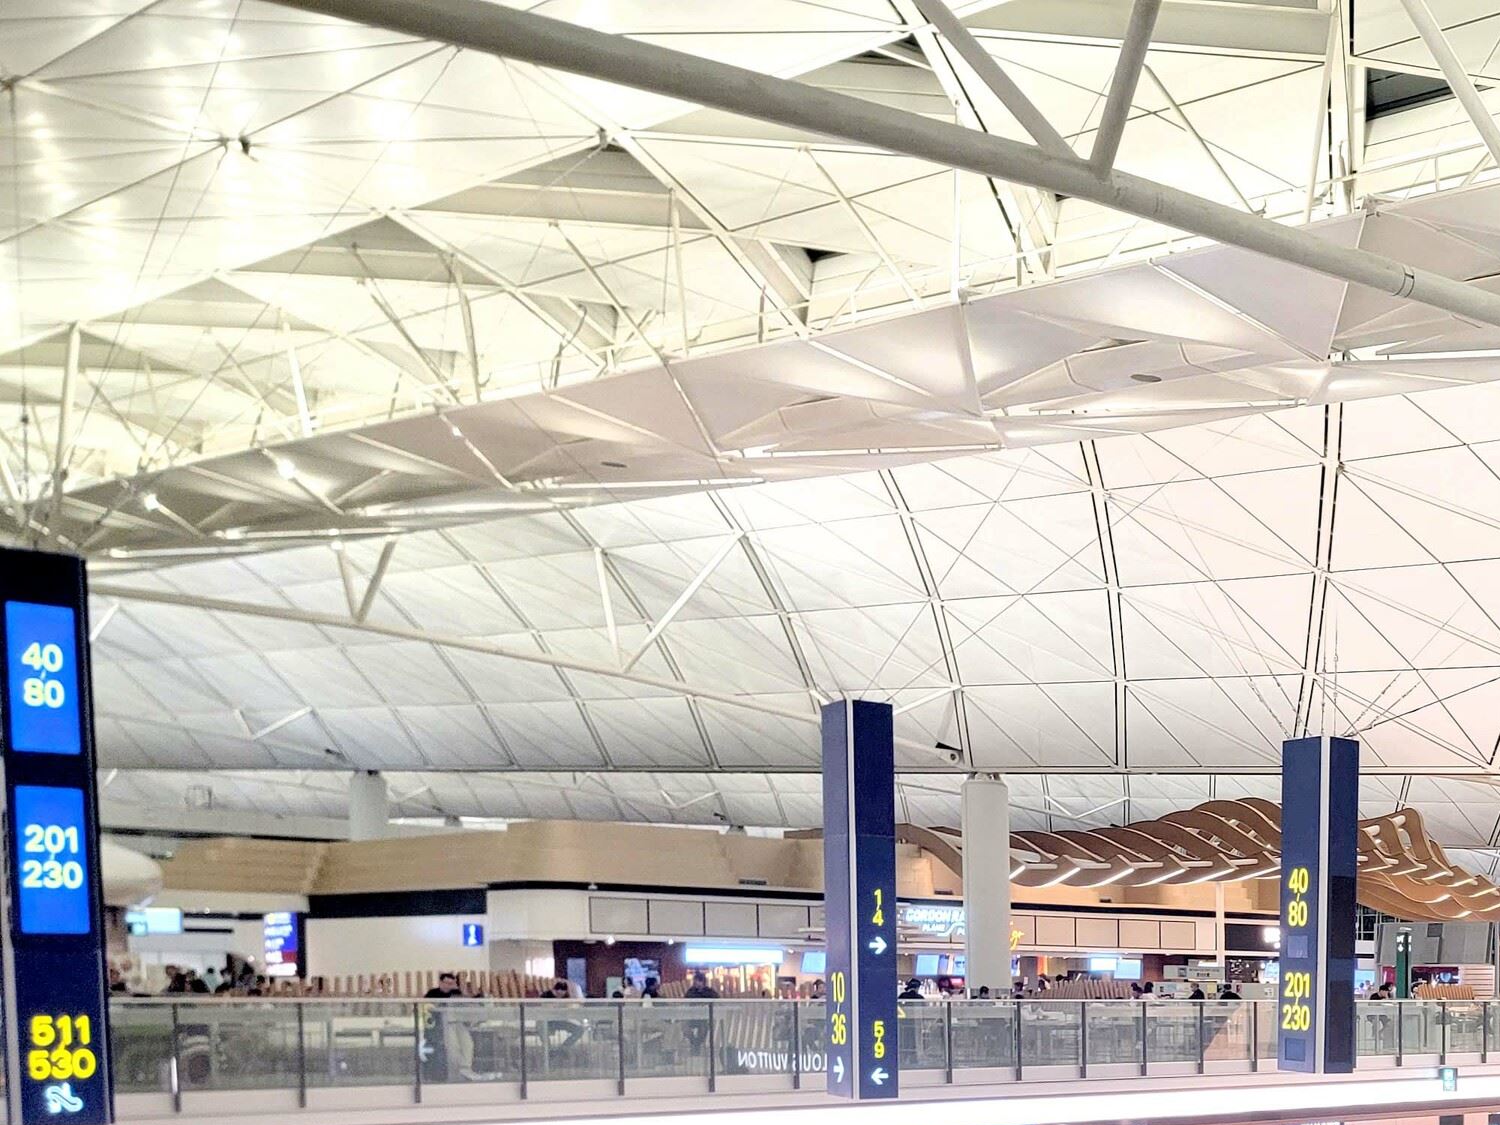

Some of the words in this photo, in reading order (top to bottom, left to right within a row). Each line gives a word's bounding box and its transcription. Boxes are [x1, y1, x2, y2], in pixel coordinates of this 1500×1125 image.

[21, 642, 64, 673] 40
[23, 678, 66, 708] 80
[24, 824, 79, 854] 201
[23, 860, 83, 890] 230
[1288, 868, 1309, 894] 40
[873, 888, 883, 906] 1
[872, 908, 884, 926] 4
[1288, 902, 1308, 927] 80
[831, 972, 845, 1003] 10
[1284, 972, 1311, 998] 201
[30, 1014, 92, 1047] 511
[831, 1013, 847, 1046] 36
[873, 1020, 885, 1039] 5
[1282, 1004, 1311, 1031] 230
[27, 1048, 97, 1080] 530
[873, 1041, 885, 1059] 9
